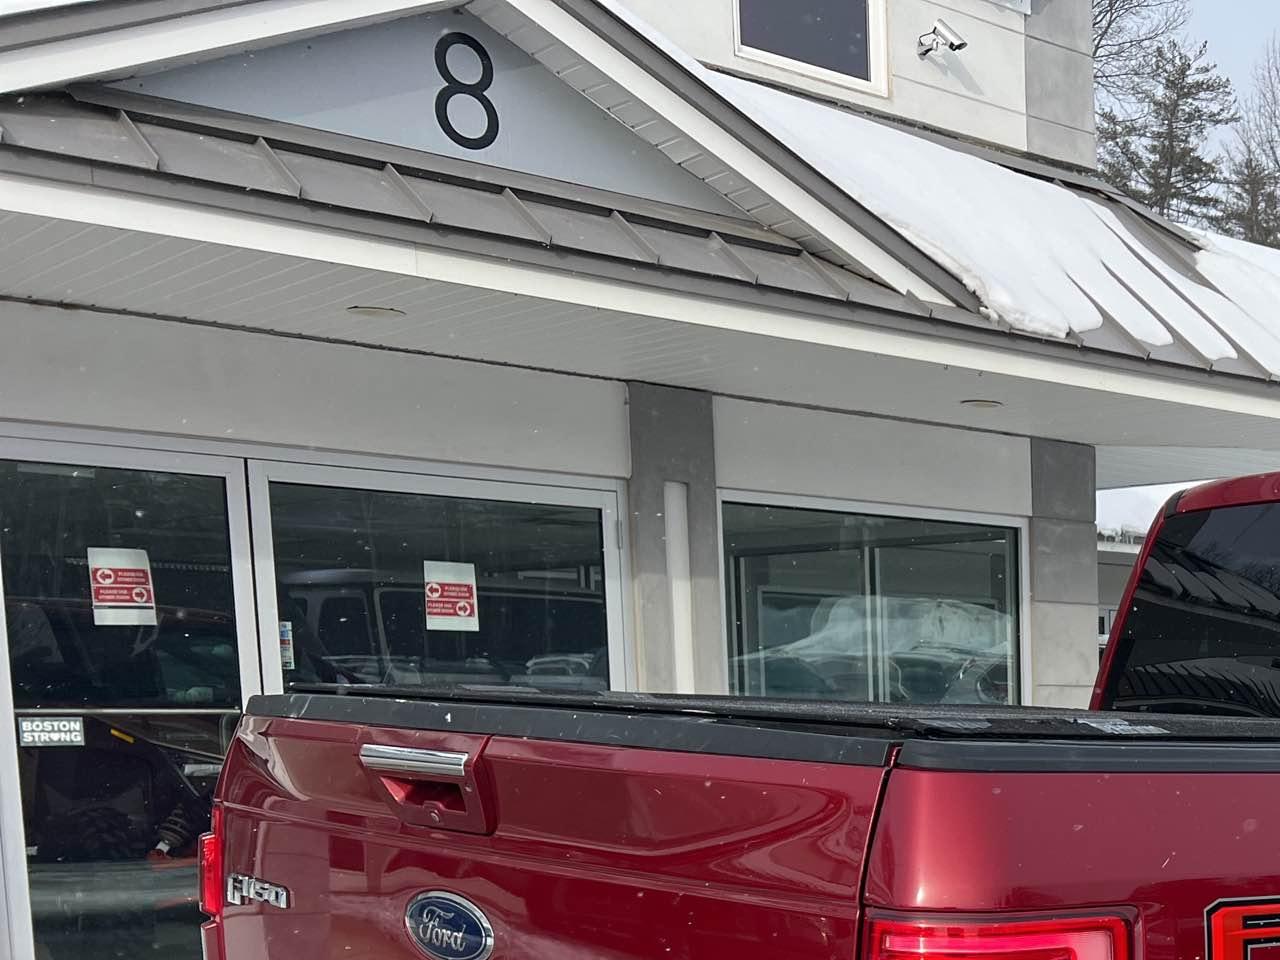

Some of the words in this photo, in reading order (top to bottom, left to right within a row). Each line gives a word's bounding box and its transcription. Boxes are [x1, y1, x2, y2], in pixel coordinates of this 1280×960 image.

[434, 31, 499, 150] 8
[22, 721, 80, 731] BOSTON
[419, 906, 467, 952] Ford
